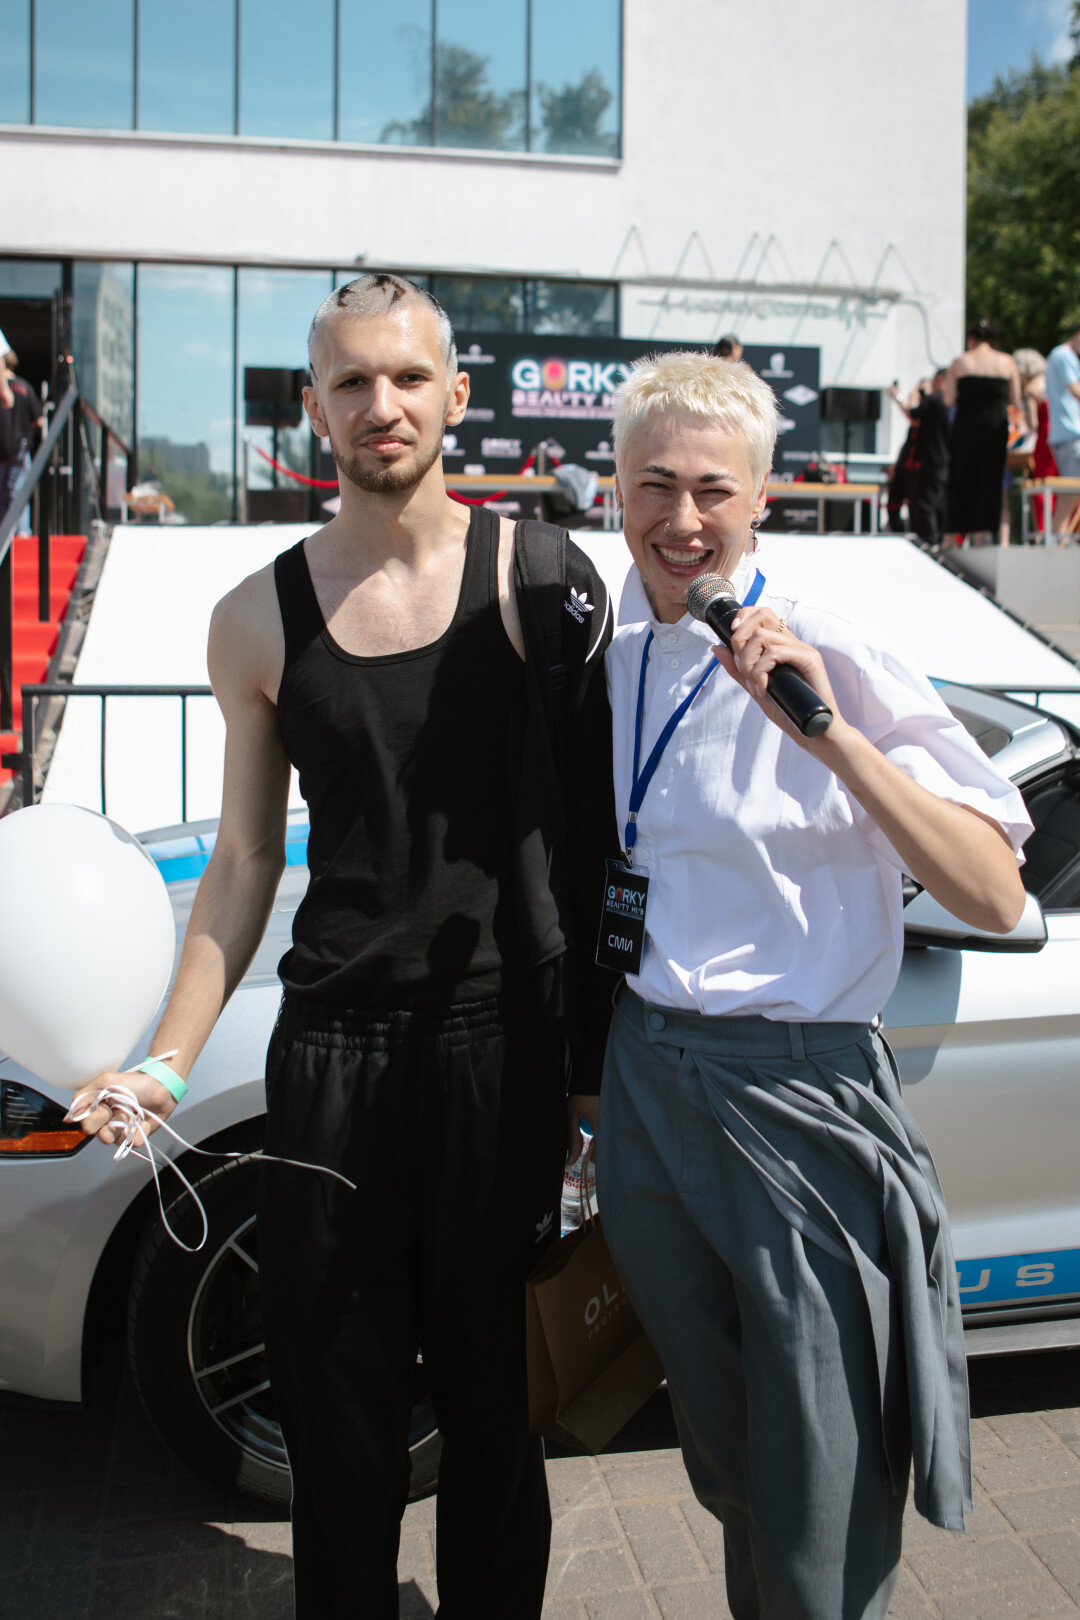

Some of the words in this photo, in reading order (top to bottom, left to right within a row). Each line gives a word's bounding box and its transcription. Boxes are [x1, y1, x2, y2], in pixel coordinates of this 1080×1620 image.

[607, 885, 646, 907] GORKY
[606, 899, 630, 911] BEAUTY
[631, 905, 644, 915] HUB
[607, 934, 634, 953] СМИ
